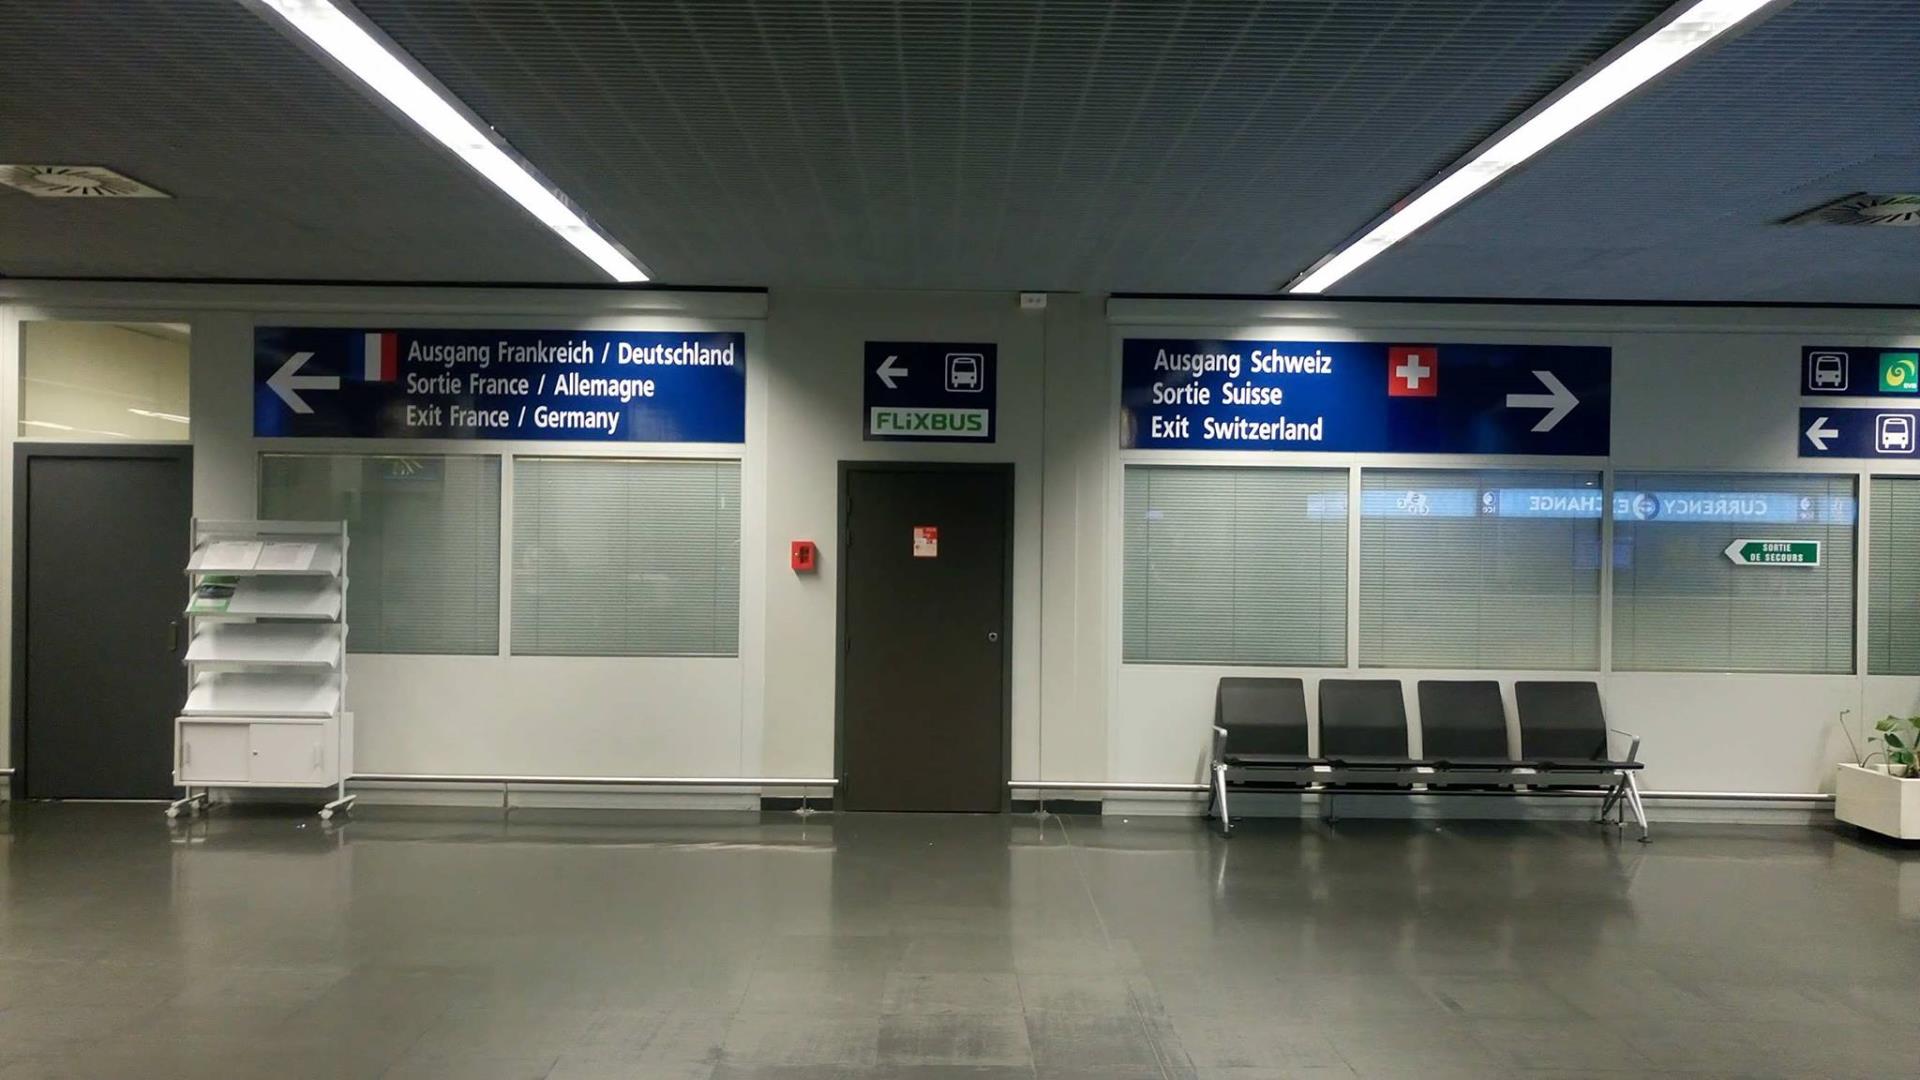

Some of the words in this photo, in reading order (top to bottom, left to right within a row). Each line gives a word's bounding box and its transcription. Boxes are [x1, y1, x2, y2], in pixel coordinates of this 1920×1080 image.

[408, 340, 490, 368] Ausgang
[498, 340, 594, 364] Frankreich
[601, 342, 610, 364] /
[618, 341, 734, 366] Deutschland
[1154, 349, 1240, 378] Ausgang
[1251, 349, 1332, 374] Schweiz
[407, 372, 462, 394] Sortie
[470, 373, 529, 395] France
[537, 373, 546, 395] /
[554, 372, 655, 403] Allemagne
[1152, 381, 1210, 405] Sortie
[1222, 381, 1282, 405] Suisse
[406, 404, 442, 426] Exit
[450, 405, 509, 427] France
[517, 405, 526, 427] /
[534, 405, 620, 435] Germany
[1151, 415, 1189, 438] Exit
[1203, 416, 1323, 441] Switzerland
[1750, 553, 1761, 562] DE
[1764, 553, 1804, 562] SECOURS
[1762, 543, 1792, 552] SORTIE
